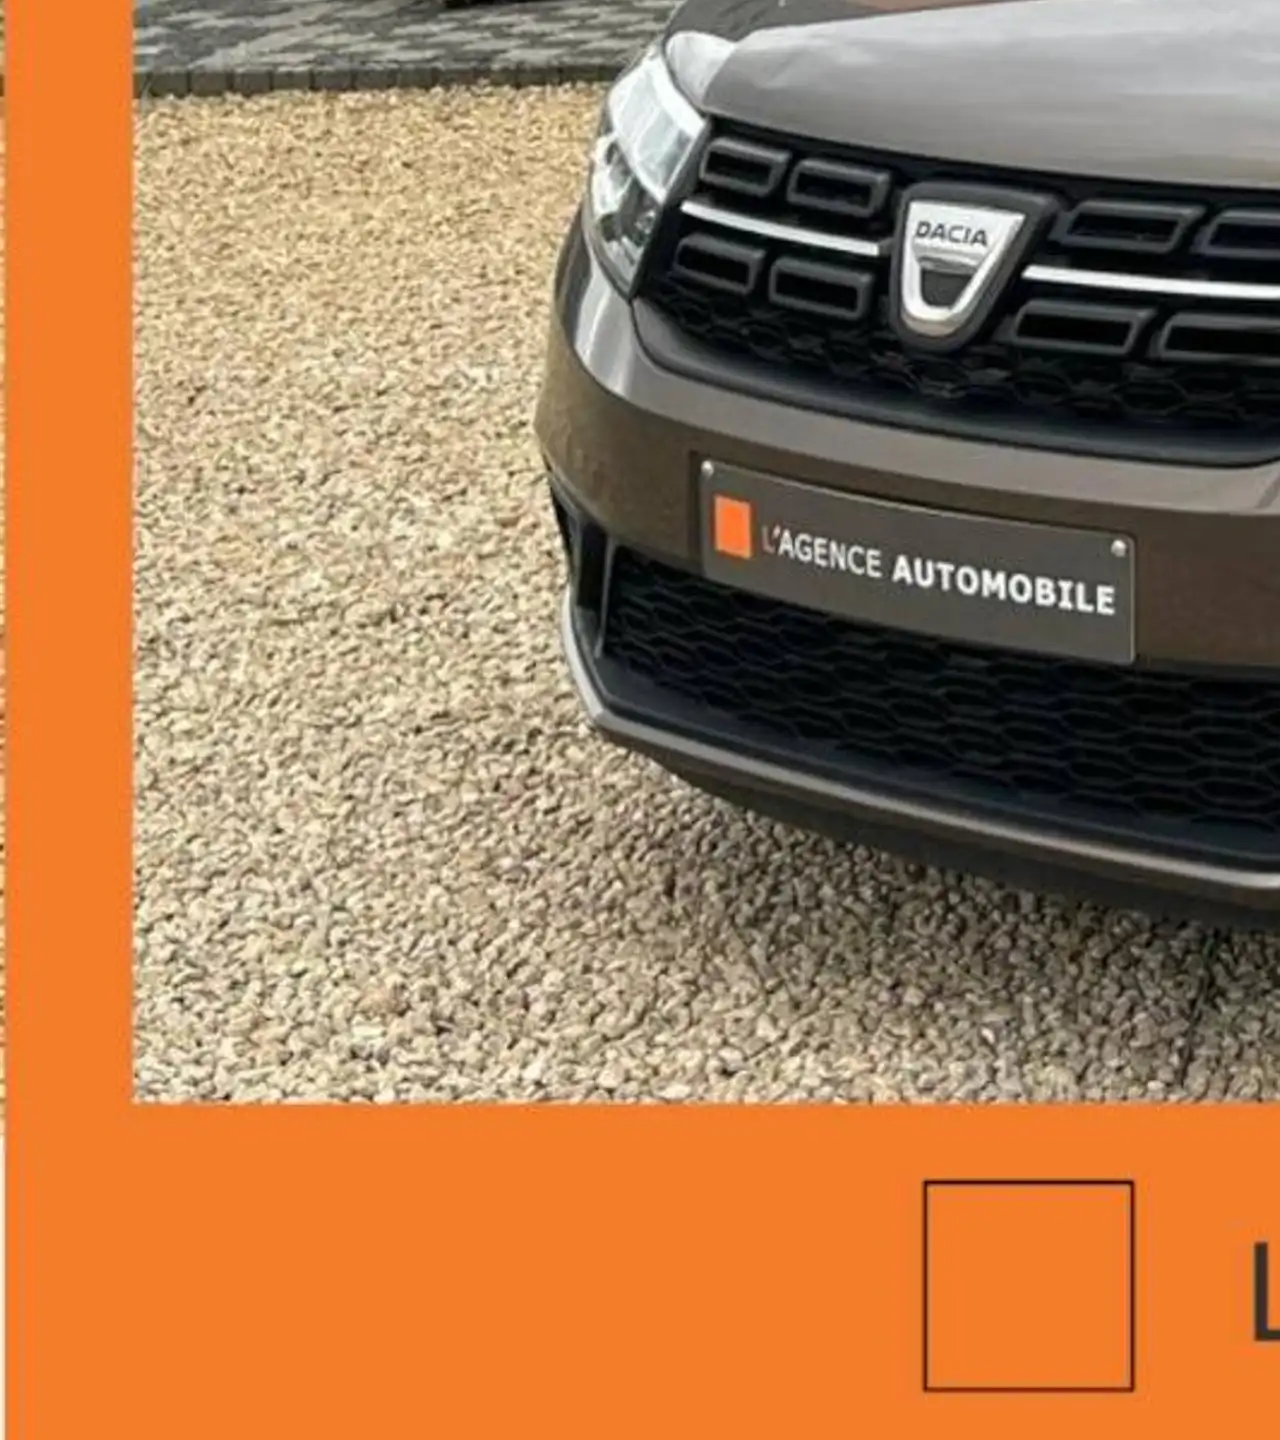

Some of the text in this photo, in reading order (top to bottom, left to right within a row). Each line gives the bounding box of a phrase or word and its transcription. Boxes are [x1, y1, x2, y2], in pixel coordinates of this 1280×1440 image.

[916, 220, 988, 248] DACIA
[762, 524, 1117, 616] L'AGENCE AUTOMOBILE
